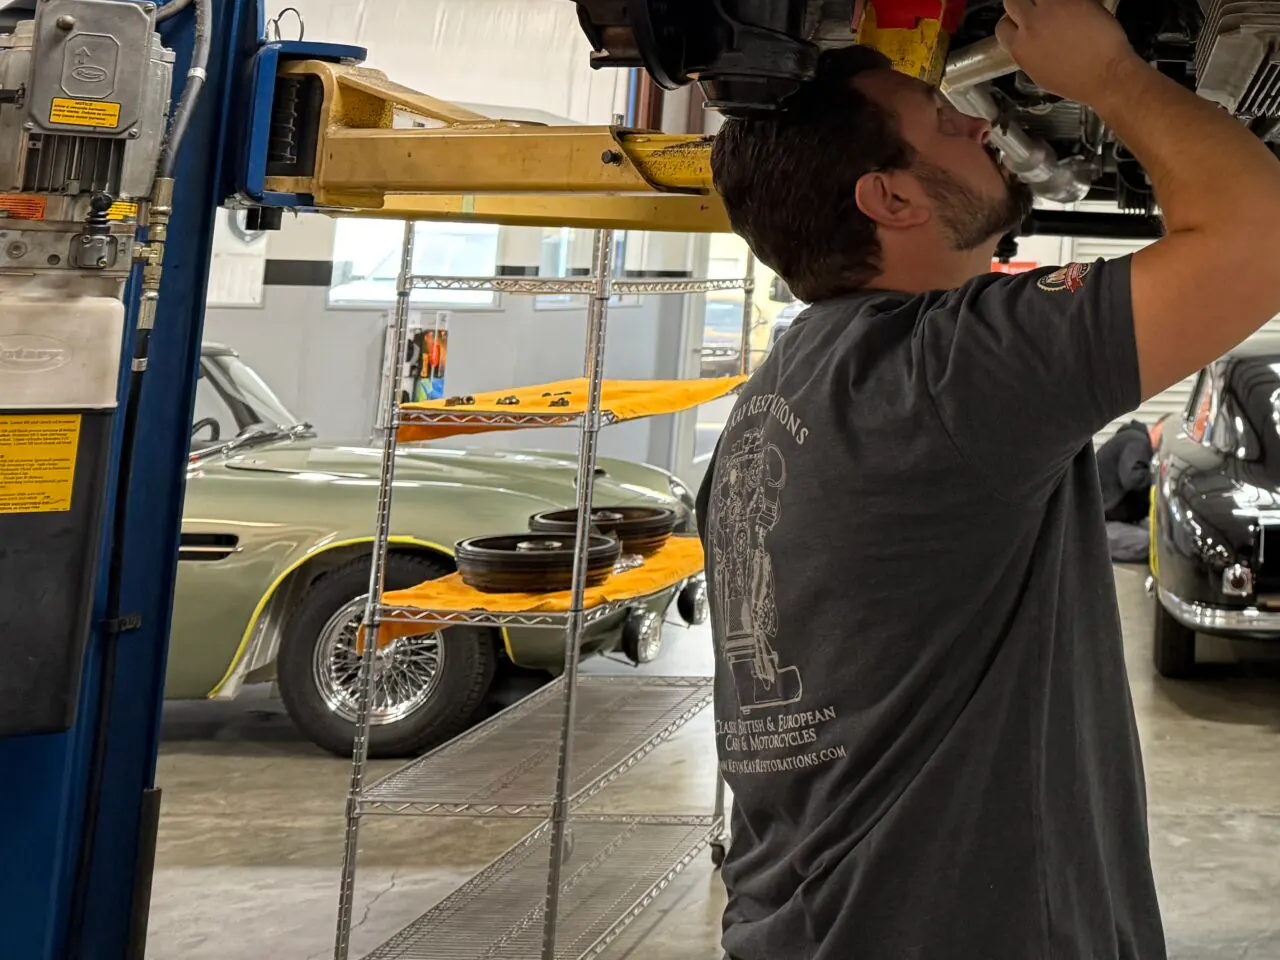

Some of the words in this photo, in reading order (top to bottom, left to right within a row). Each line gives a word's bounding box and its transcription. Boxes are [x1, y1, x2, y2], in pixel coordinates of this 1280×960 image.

[766, 716, 776, 732] &
[778, 705, 837, 732] EUROPEAN
[749, 727, 817, 751] MOTORCYCLES
